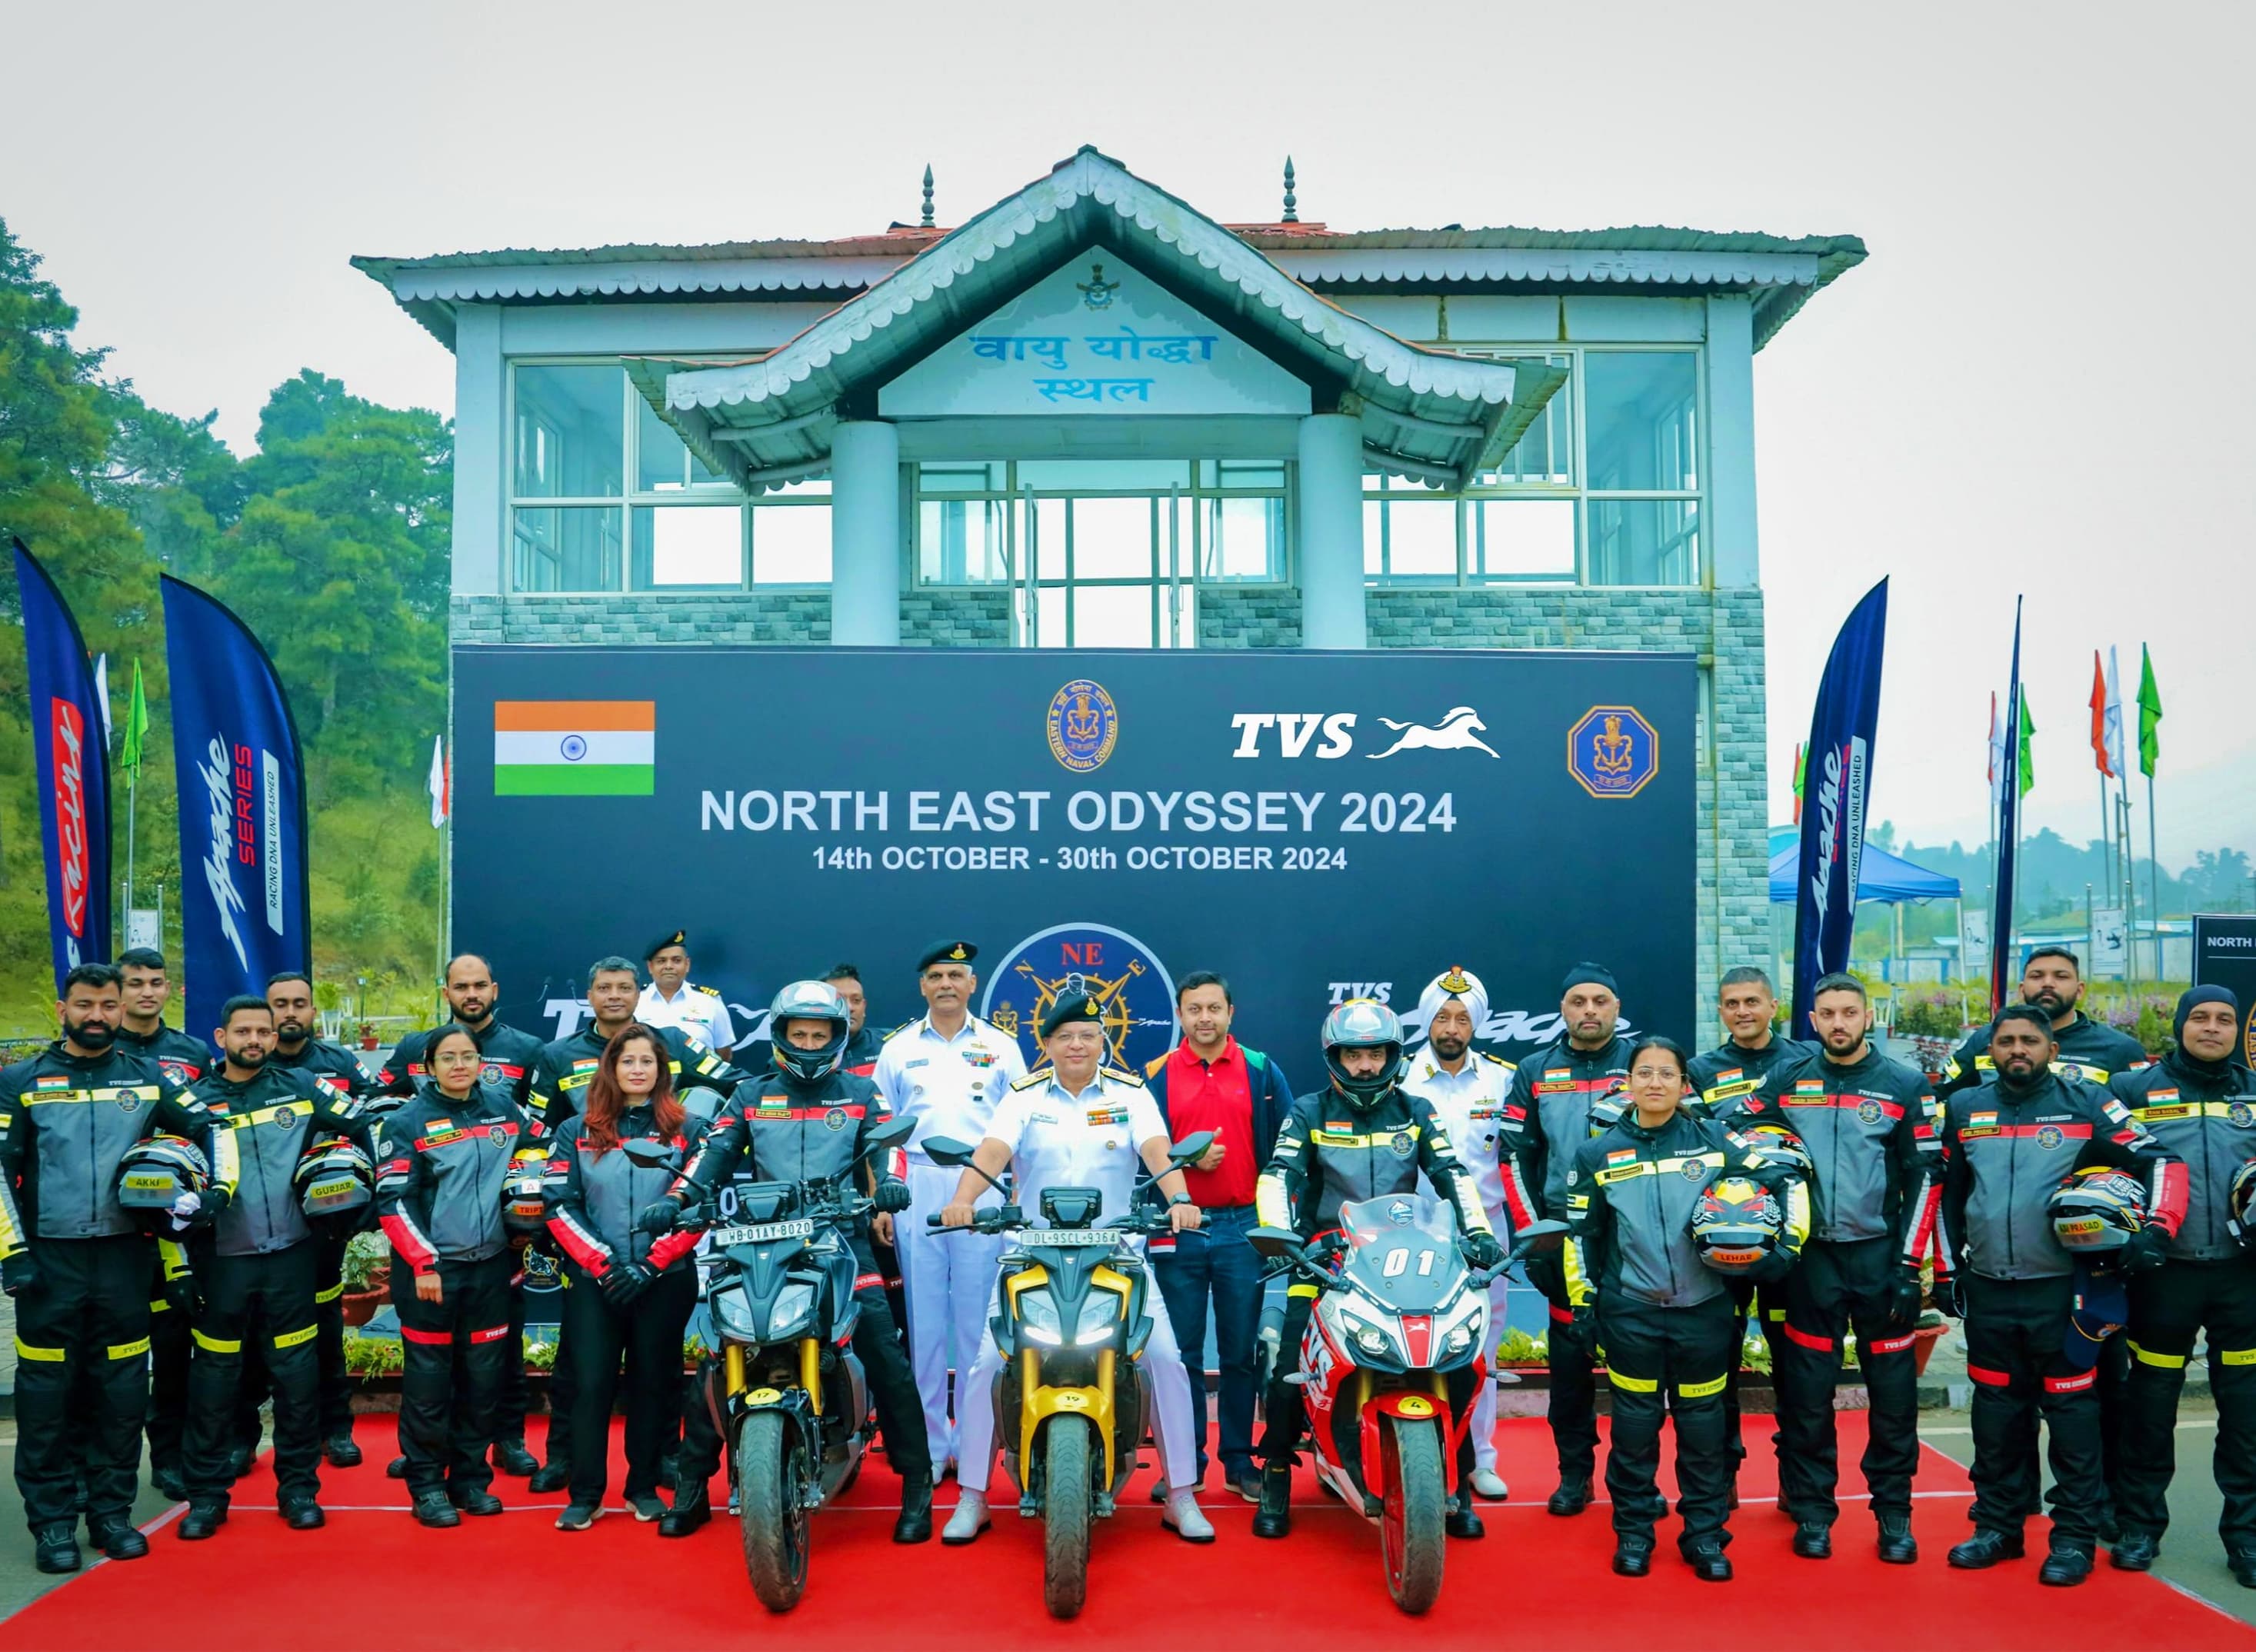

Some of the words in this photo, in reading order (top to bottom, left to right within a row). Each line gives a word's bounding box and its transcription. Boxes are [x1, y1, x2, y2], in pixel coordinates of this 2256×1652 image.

[968, 335, 1070, 370] वायु
[1084, 326, 1220, 364] योद्धा
[1032, 378, 1156, 404] स्थल
[1049, 720, 1068, 758] EASTERN
[1066, 757, 1095, 768] NAVAL
[1095, 720, 1115, 762] COMMAND
[1231, 713, 1358, 759] TVS
[1851, 755, 1862, 823] UNLEASHED
[235, 744, 255, 867] SERIES
[268, 771, 277, 836] UNLEASHED
[702, 791, 888, 831] NORTH
[910, 791, 1050, 831] EAST
[1068, 791, 1325, 832] ODYSSEY
[1341, 792, 1457, 832] 2024
[1851, 825, 1860, 849] DNA
[269, 838, 278, 865] DNA
[813, 847, 871, 870] 14th
[882, 847, 1029, 870] OCTOBER
[1058, 847, 1117, 870] 30th
[1126, 847, 1275, 870] OCTOBER
[1282, 847, 1348, 870] 2024
[269, 866, 278, 909] RACING
[1061, 943, 1104, 966] NE
[2207, 937, 2252, 948] NORTH
[1014, 960, 1035, 979] N
[1127, 959, 1147, 978] E
[1328, 982, 1393, 1004] TVS
[135, 1178, 160, 1187] AKKI
[315, 1182, 352, 1196] GURJAR
[1382, 1247, 1436, 1277] 01
